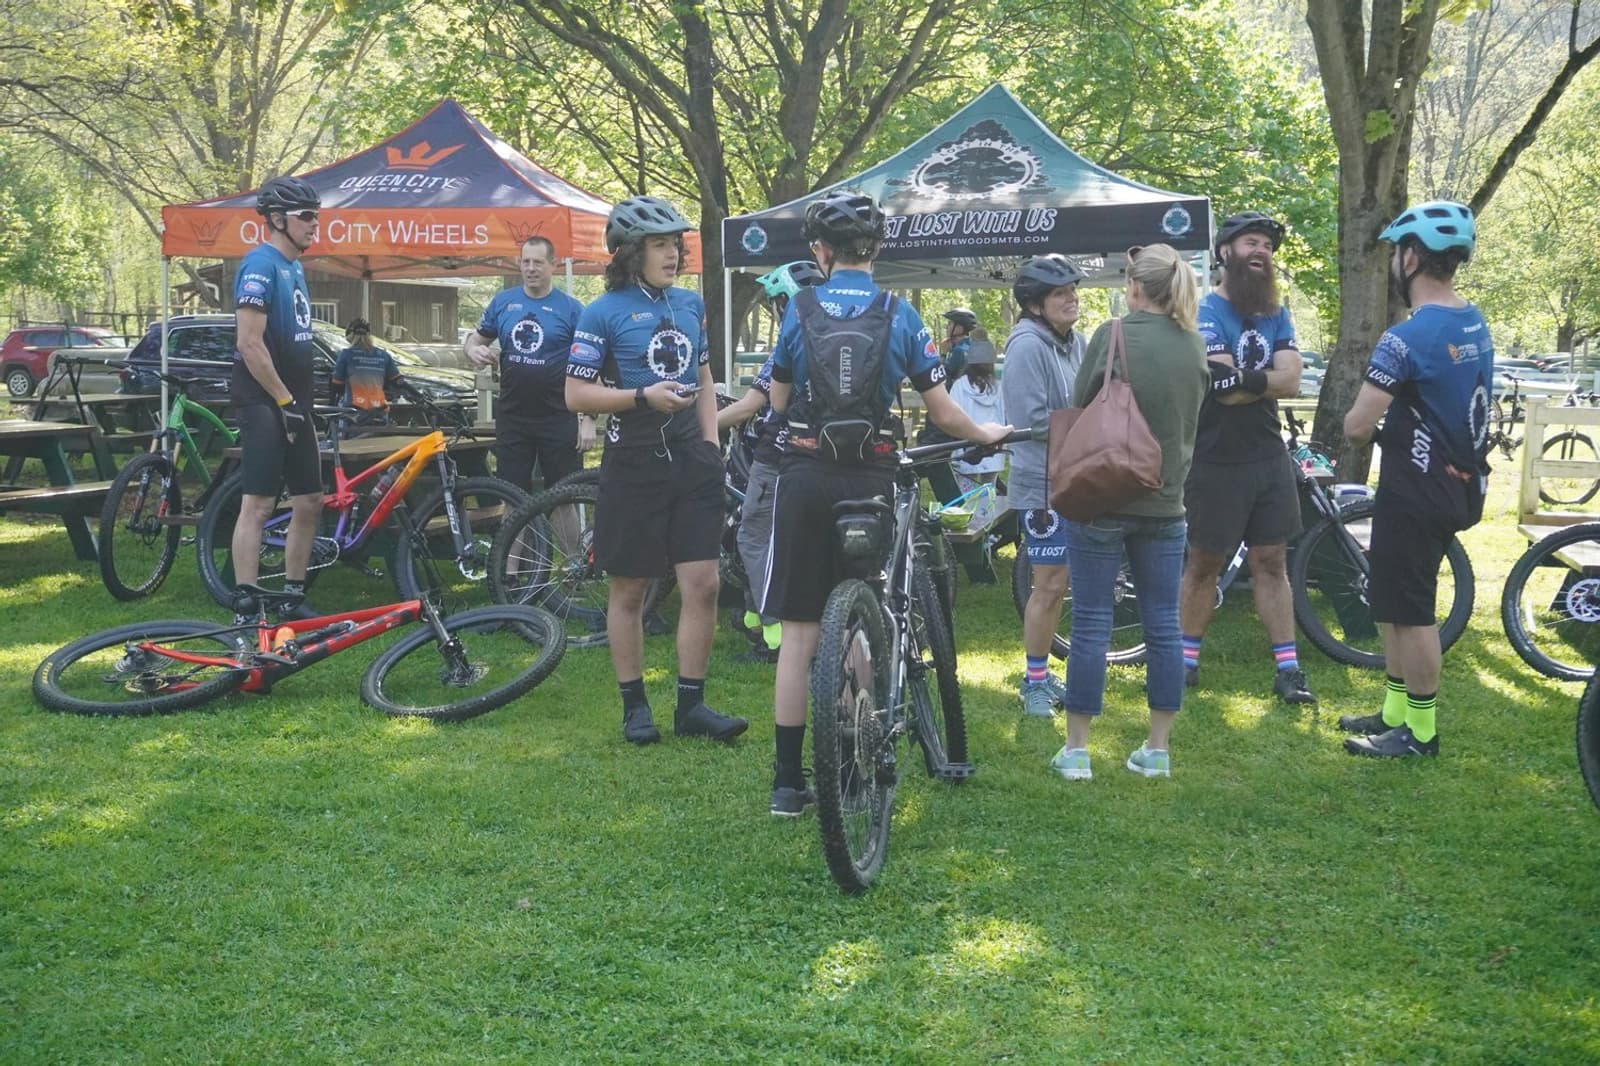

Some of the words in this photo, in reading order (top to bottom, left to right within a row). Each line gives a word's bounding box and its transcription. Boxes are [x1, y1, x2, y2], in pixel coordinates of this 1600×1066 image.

[339, 174, 407, 189] QUEEN
[406, 173, 457, 189] CITY
[908, 211, 962, 237] LOST
[963, 209, 1022, 235] WITH
[1025, 207, 1058, 233] US
[240, 220, 320, 246] QUN
[327, 219, 382, 243] CITY
[387, 220, 489, 245] WHEELS
[880, 236, 1049, 249] WW.LOSTINTHEWOODSMTB.COM
[827, 288, 873, 297] TREK
[574, 330, 607, 345] REK
[573, 365, 599, 379] LOST
[840, 346, 852, 395] CAMELBAK
[1368, 369, 1397, 387] LOST
[1214, 376, 1236, 390] FOX
[1411, 428, 1432, 473] LOST
[1041, 546, 1067, 557] LOST
